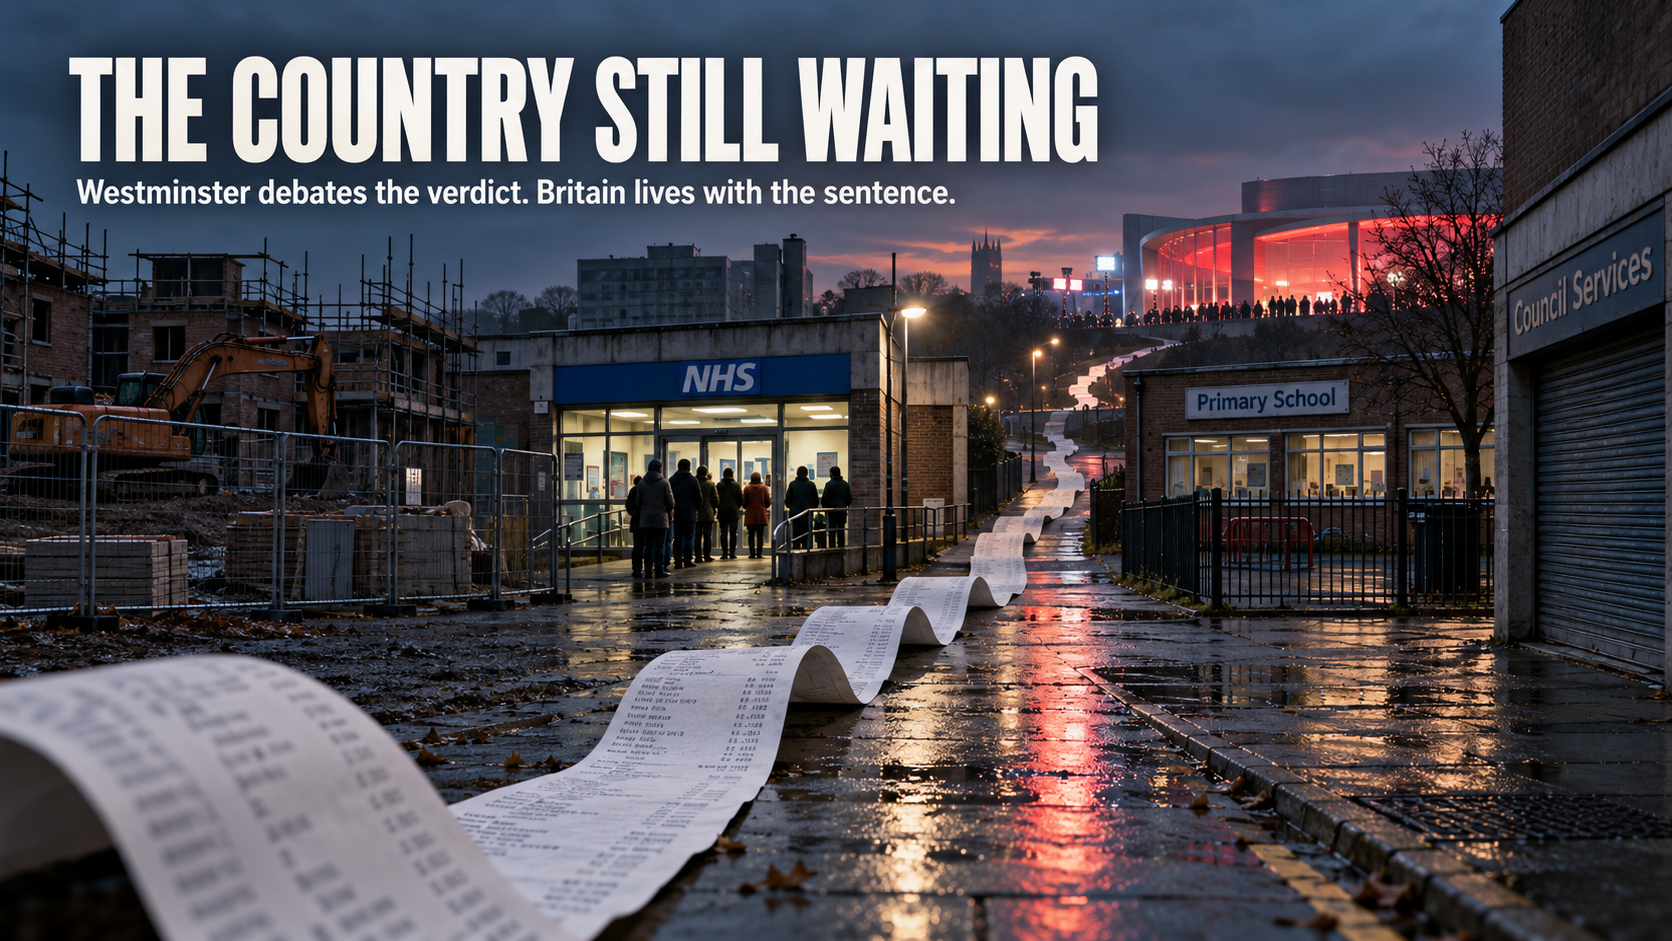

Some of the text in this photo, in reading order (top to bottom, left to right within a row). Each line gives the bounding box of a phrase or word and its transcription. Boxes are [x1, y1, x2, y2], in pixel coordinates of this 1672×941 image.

[1514, 246, 1653, 335] Council Services
[682, 362, 756, 393] NHS
[1197, 387, 1336, 413] Primary School
